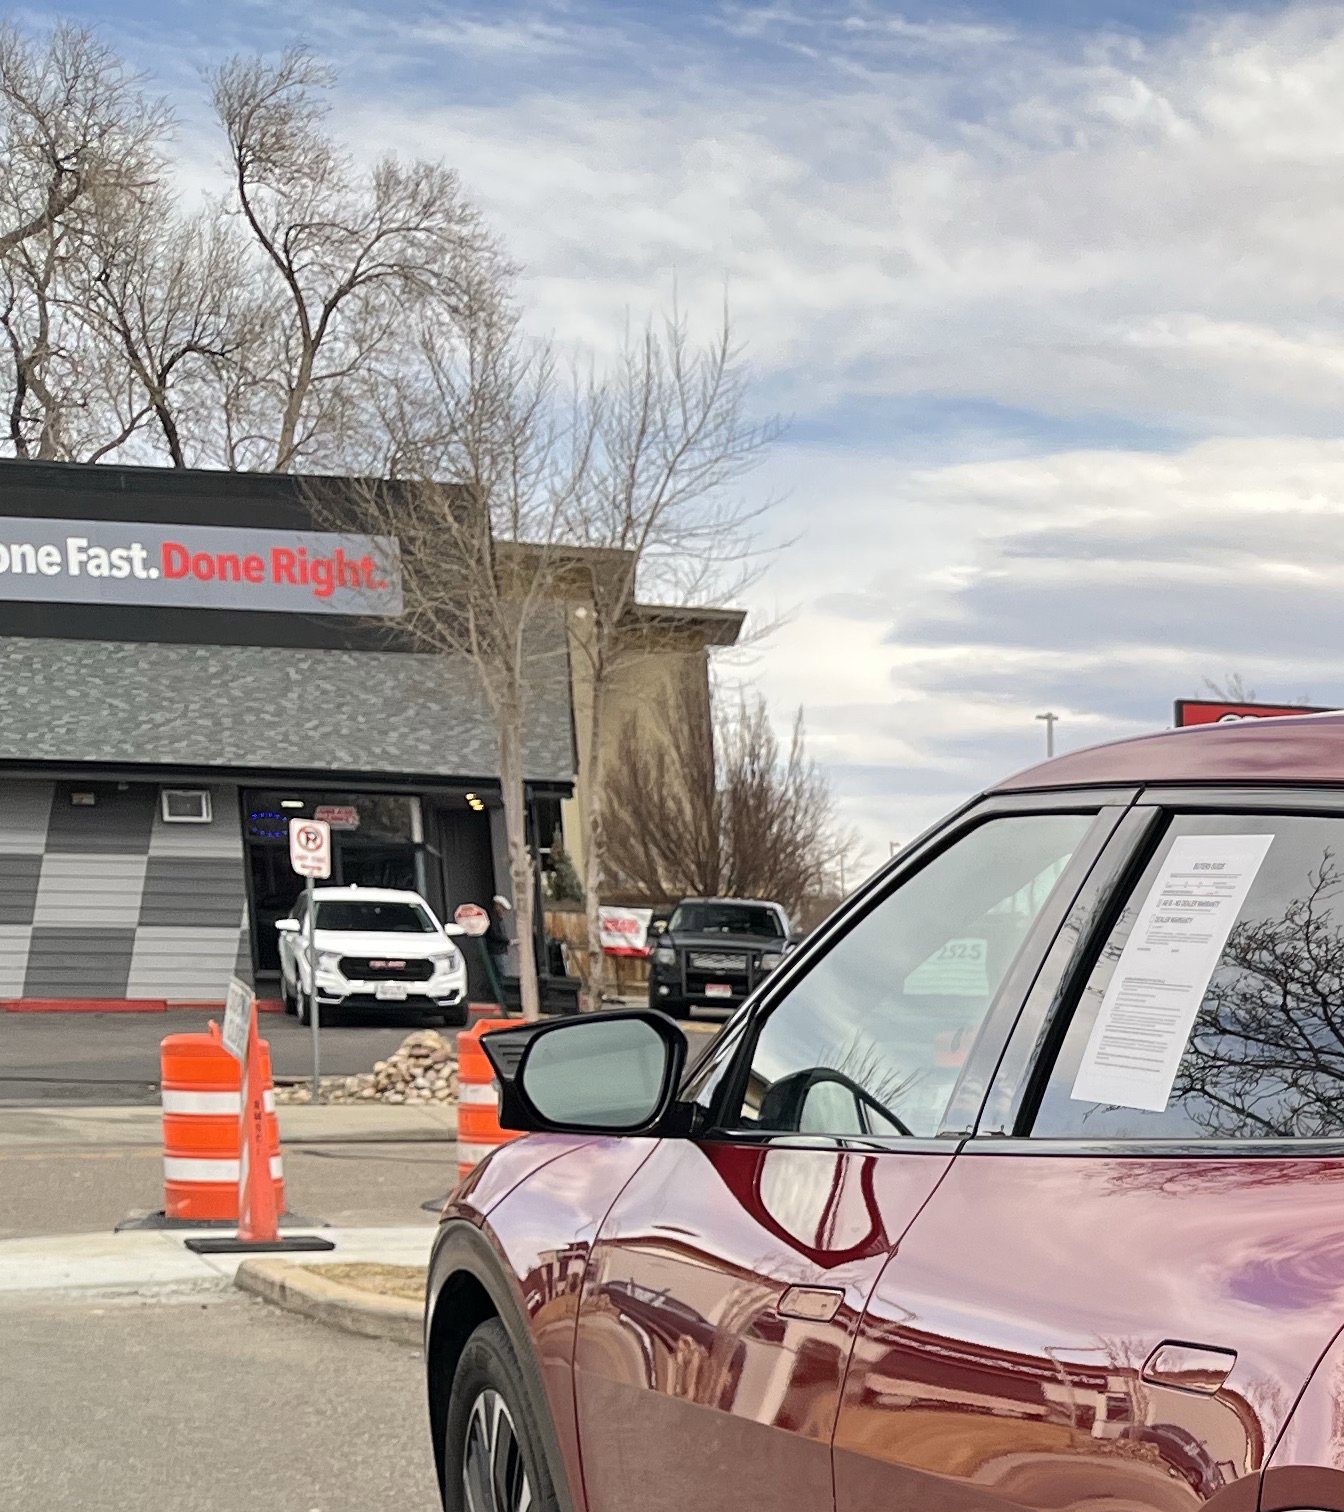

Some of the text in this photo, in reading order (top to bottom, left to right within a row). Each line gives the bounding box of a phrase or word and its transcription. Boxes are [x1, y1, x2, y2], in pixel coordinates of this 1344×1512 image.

[66, 536, 160, 580] Fast.
[161, 541, 265, 583] Done
[270, 546, 390, 598] Right.
